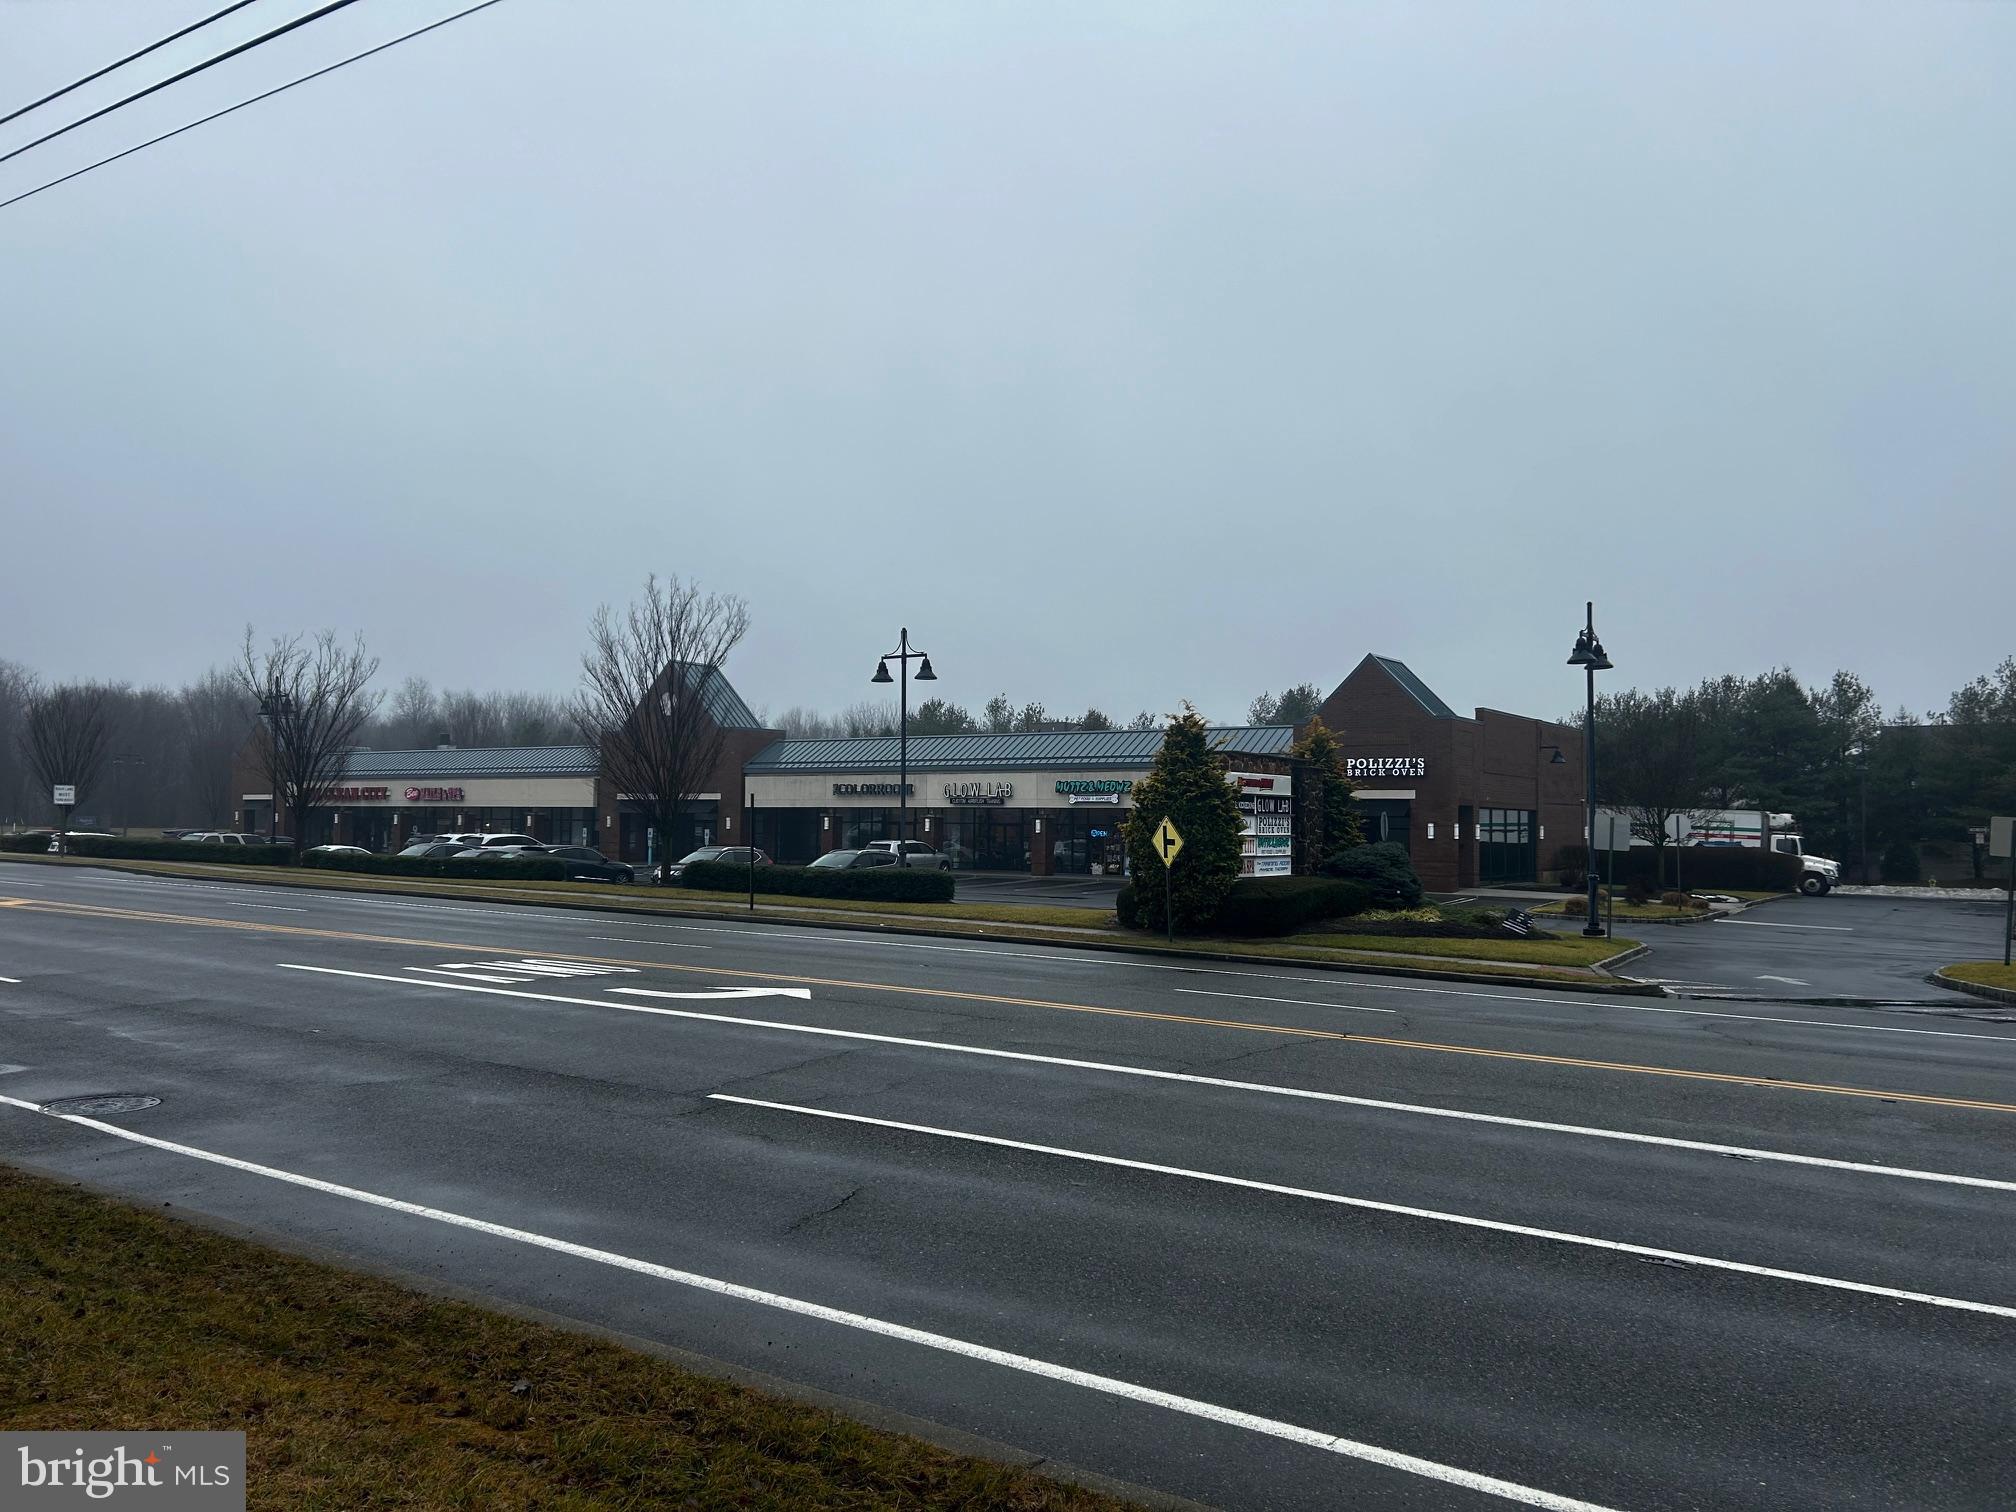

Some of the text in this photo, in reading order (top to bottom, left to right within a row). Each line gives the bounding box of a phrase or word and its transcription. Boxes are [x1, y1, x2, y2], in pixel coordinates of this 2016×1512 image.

[1346, 757, 1425, 769] POLIZZI'S
[1346, 767, 1425, 777] BRICK OVEN
[943, 782, 1013, 798] GLOW LAB
[1257, 798, 1275, 813] GLOW
[1258, 816, 1290, 827] POLIZZI'S
[1090, 829, 1108, 838] OPEN
[1258, 826, 1275, 834] BRICK
